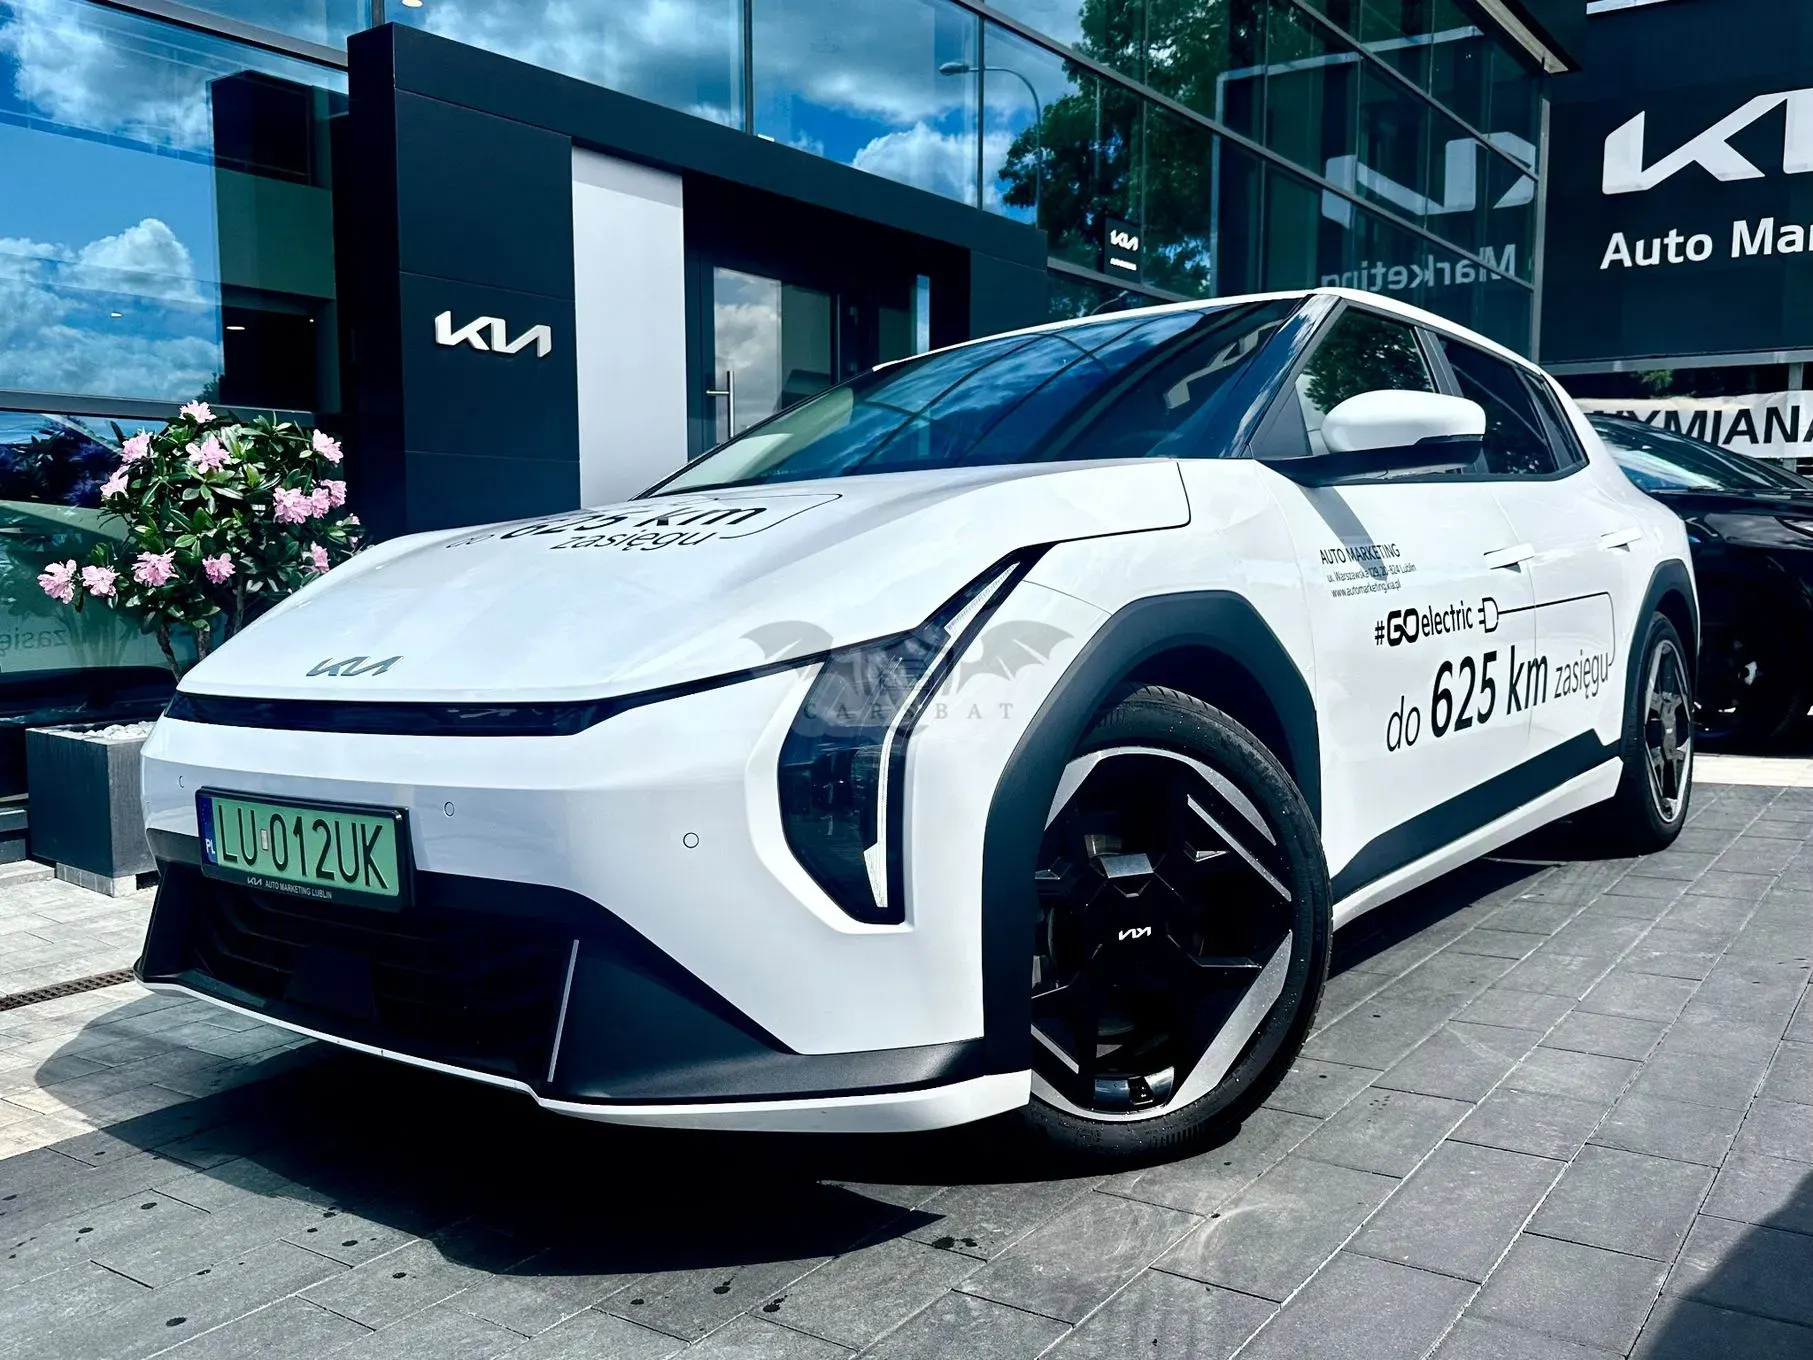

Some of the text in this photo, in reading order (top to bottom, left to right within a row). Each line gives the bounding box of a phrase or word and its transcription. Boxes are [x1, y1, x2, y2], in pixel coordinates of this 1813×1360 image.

[1110, 229, 1139, 251] KIA
[1600, 216, 1813, 270] Auto Ma
[434, 310, 552, 358] KIA
[632, 507, 767, 528] km
[549, 529, 717, 551] zasięgu
[1320, 543, 1401, 565] AUTO MARKETING
[305, 655, 405, 677] KIA
[1386, 644, 1609, 752] do 625 km zasięgu
[205, 838, 216, 855] PL
[217, 804, 389, 890] LU 012UK
[265, 880, 280, 890] AUTO
[280, 883, 312, 897] MARKETING
[311, 888, 333, 900] LUBLIN
